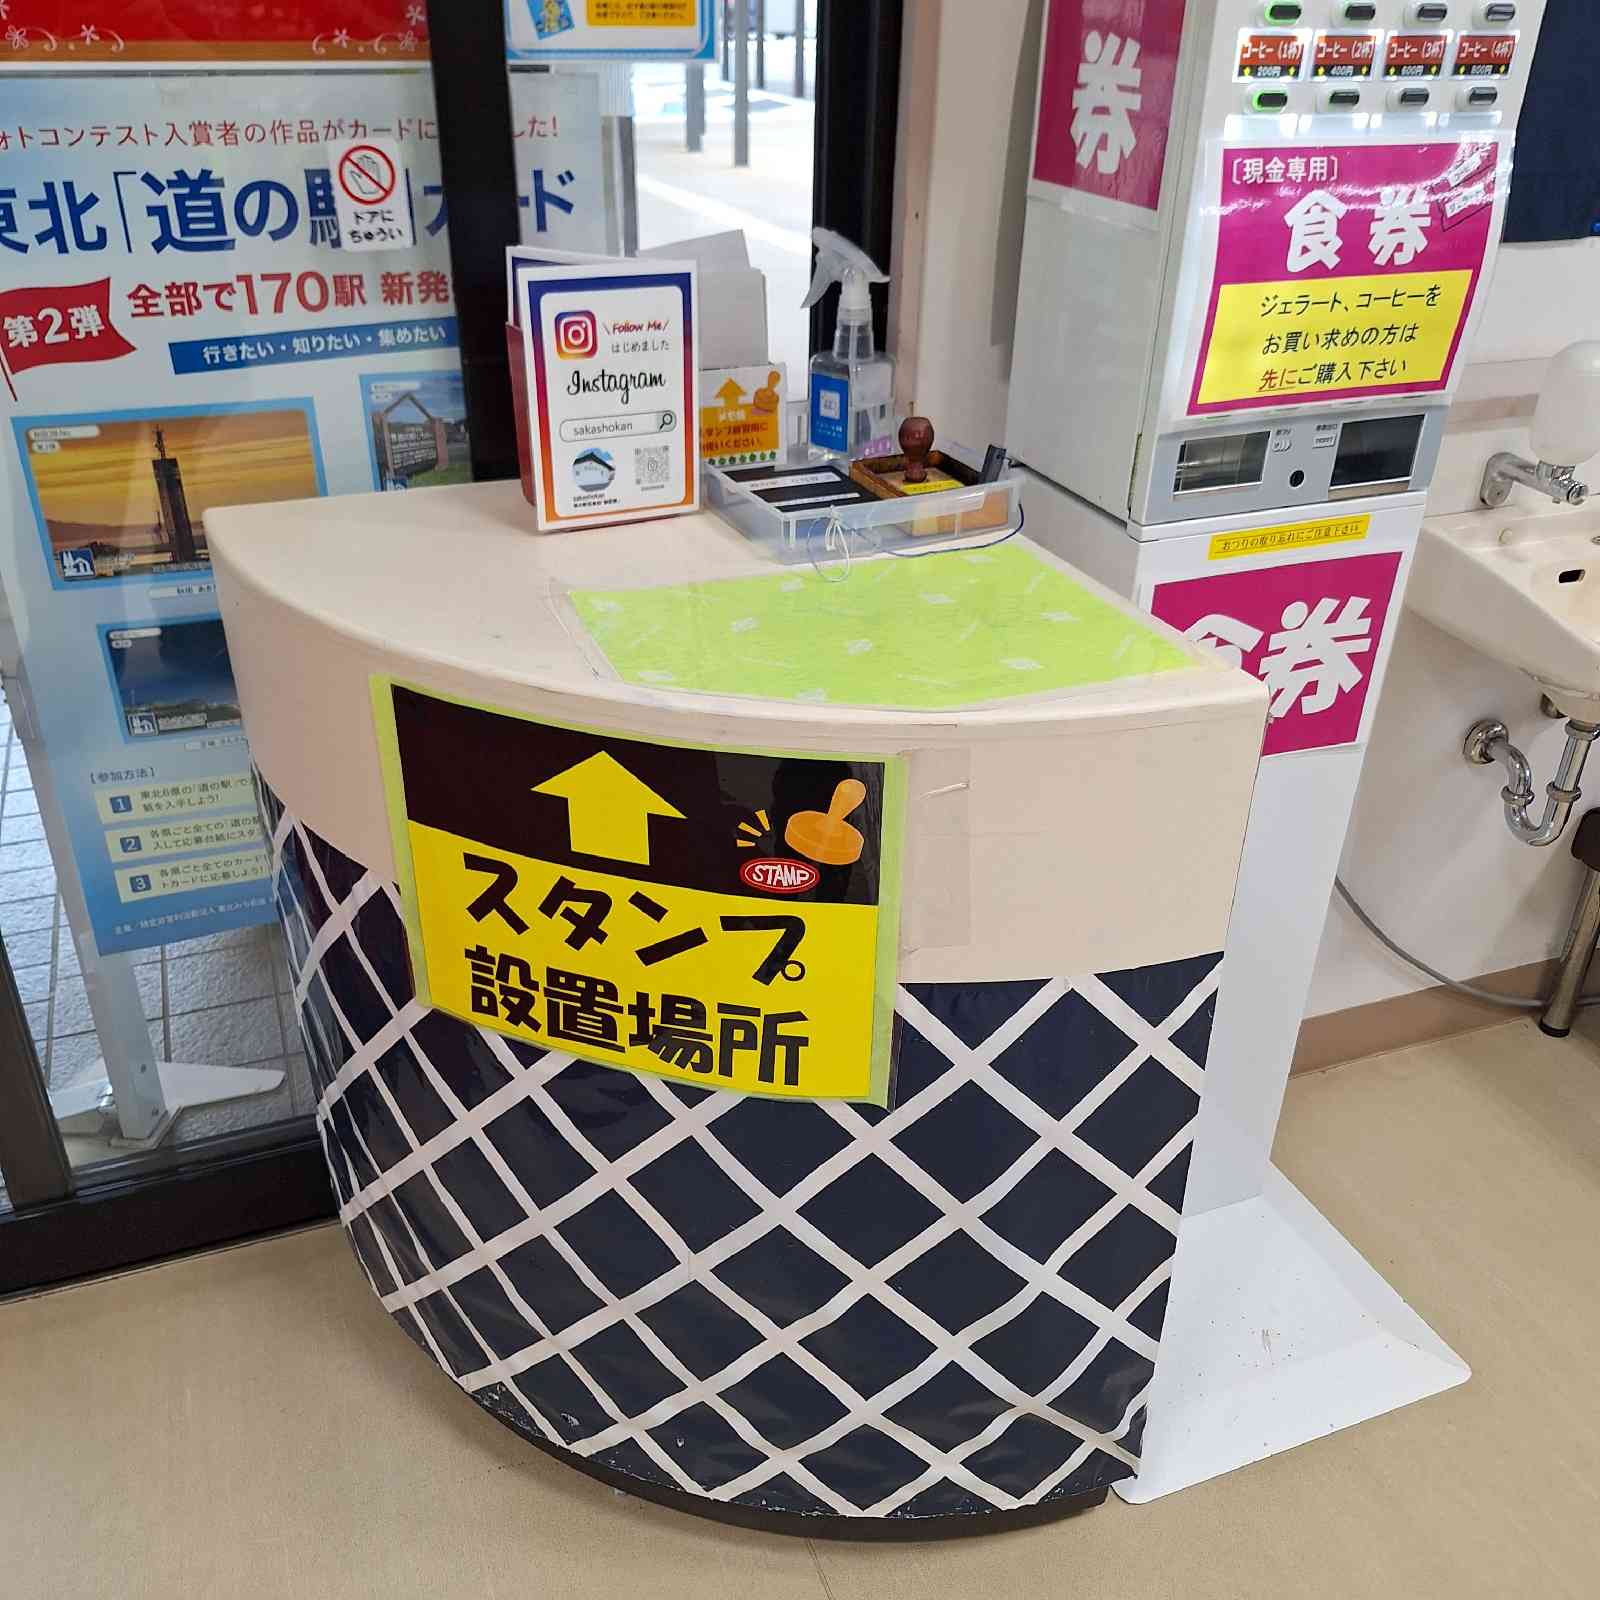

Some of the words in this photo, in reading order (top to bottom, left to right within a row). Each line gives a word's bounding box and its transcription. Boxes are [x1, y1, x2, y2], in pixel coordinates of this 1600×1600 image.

[127, 271, 367, 318] 全部で170駅
[1260, 284, 1442, 317] ジェラート、コーヒーを
[3, 304, 105, 348] 第2弾
[1262, 323, 1420, 355] お買い求めの方は
[611, 340, 670, 353] はじめました
[566, 369, 666, 404] Instagram
[1258, 360, 1407, 391] 先にご購入下さい
[573, 421, 633, 436] sakashokan
[752, 865, 810, 887] STAMP
[462, 851, 807, 987] スタンプ
[464, 943, 810, 1088] 設置場所
